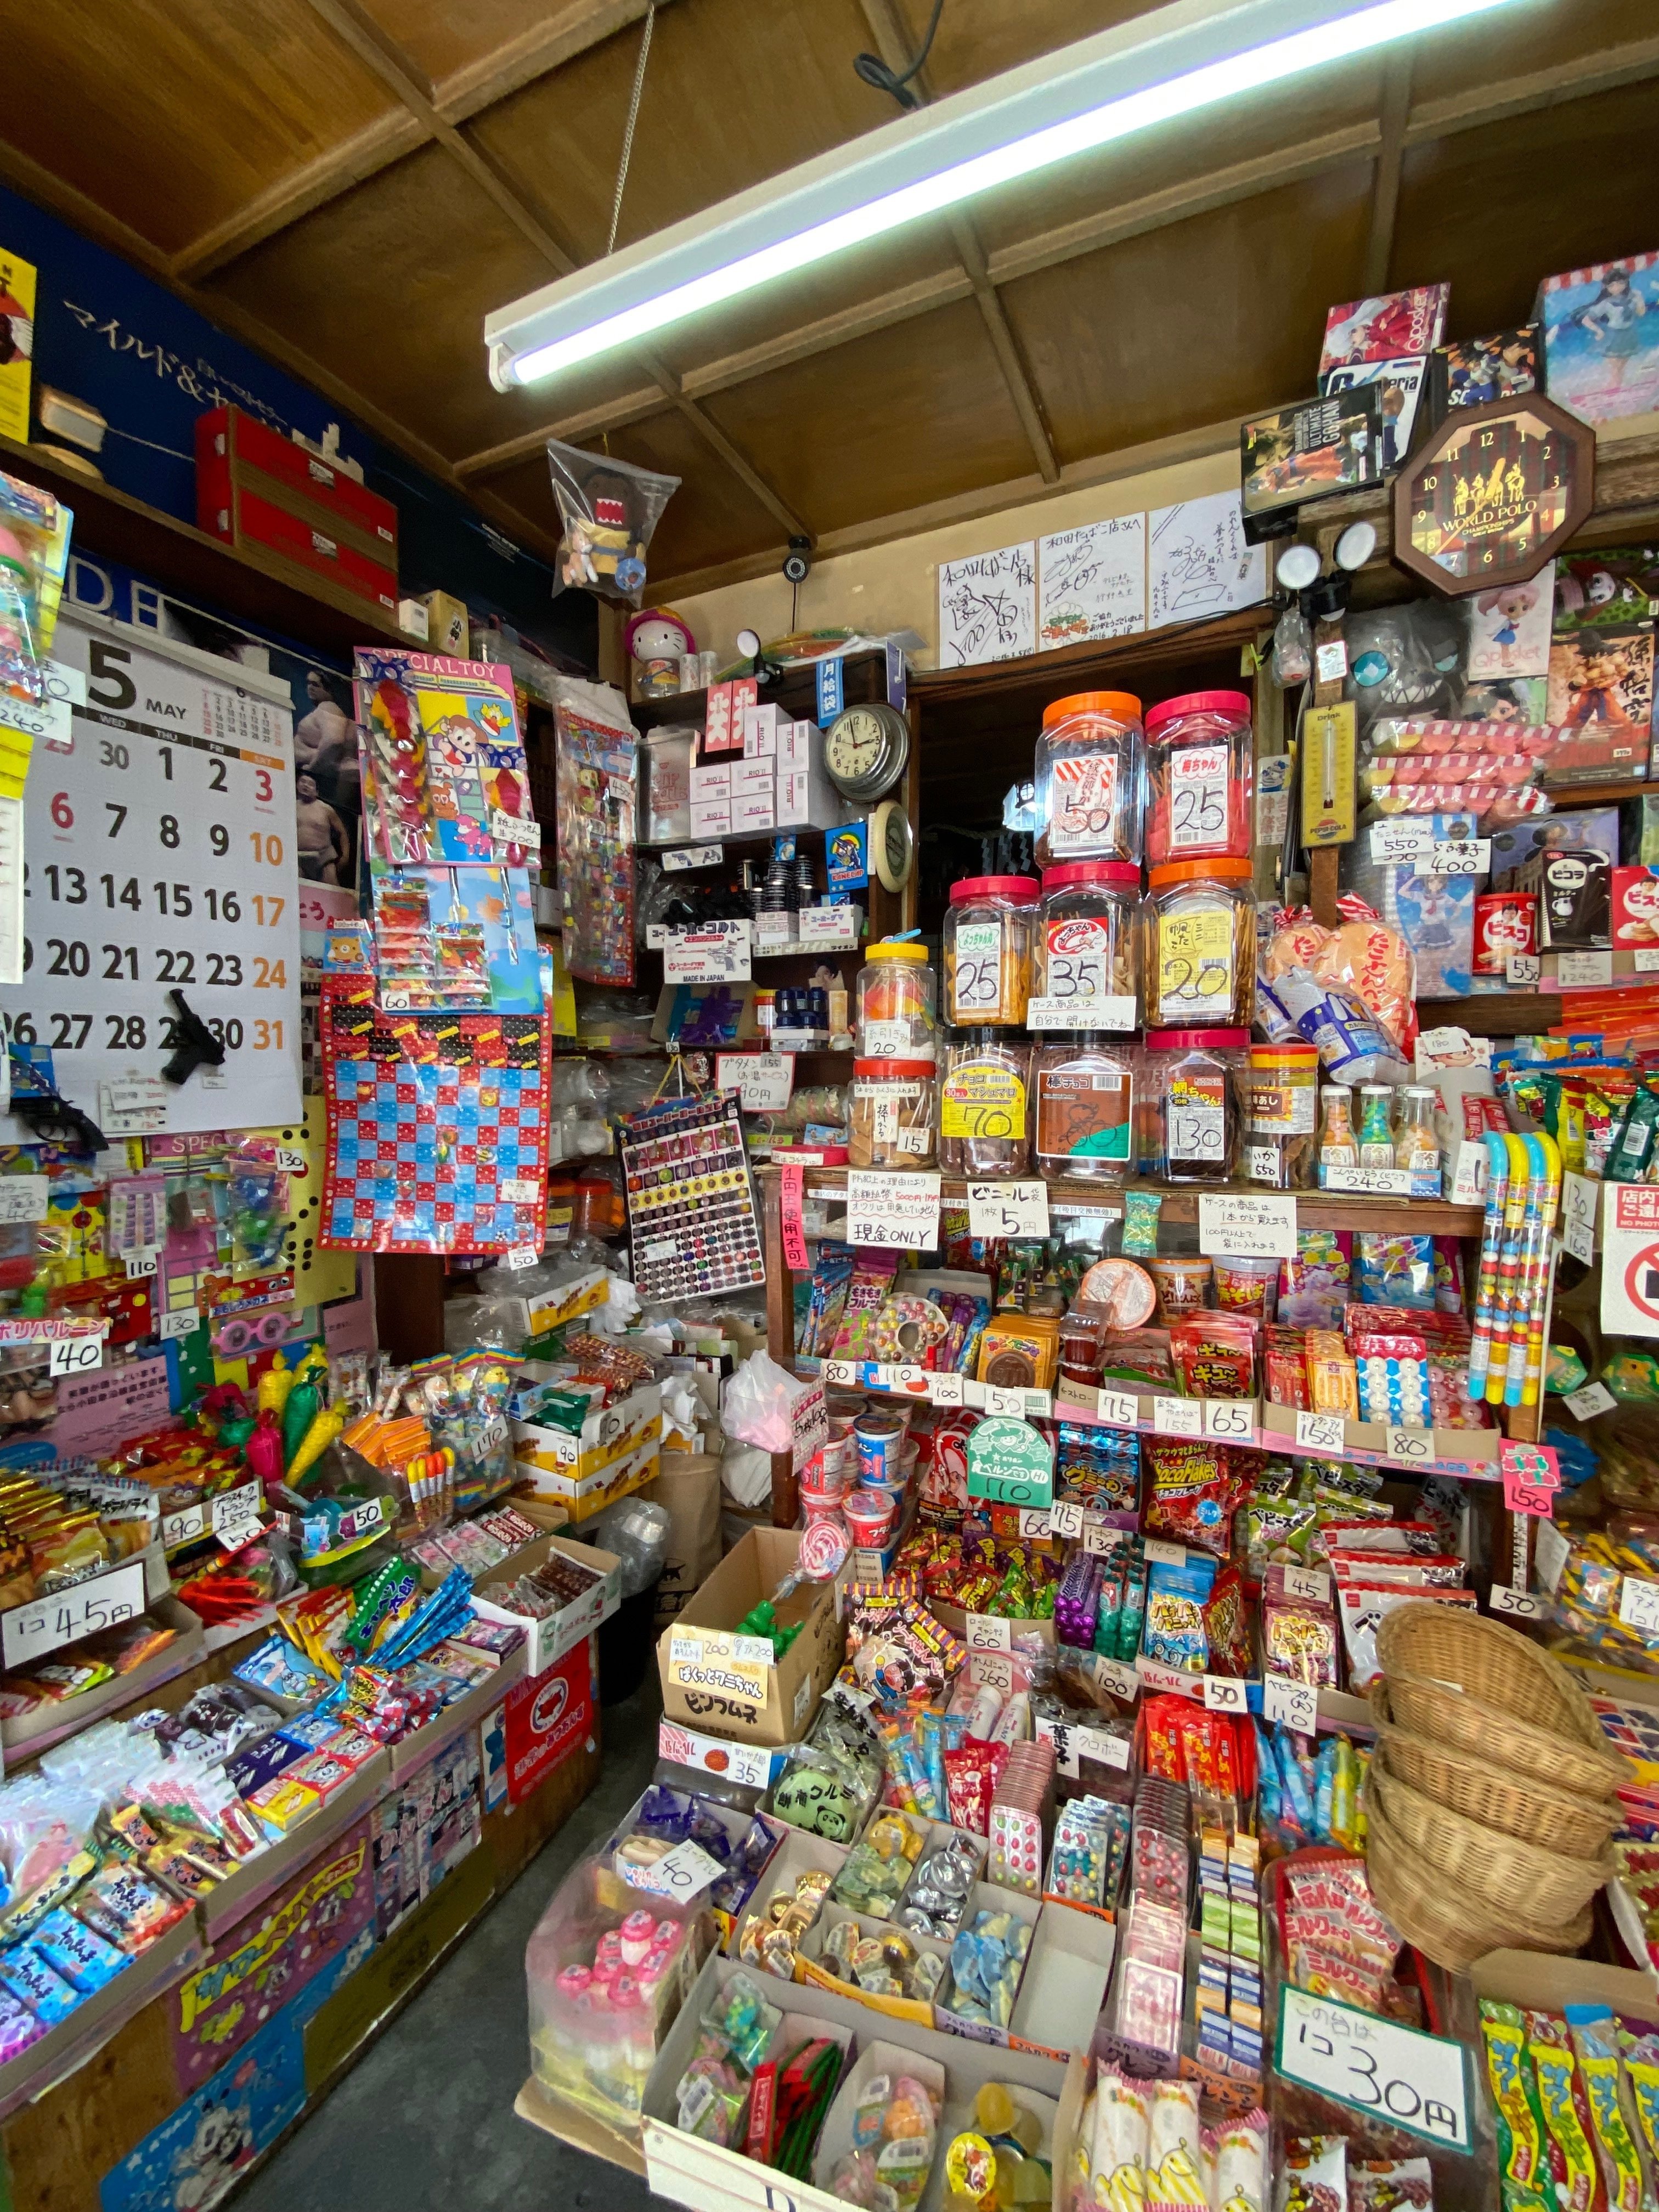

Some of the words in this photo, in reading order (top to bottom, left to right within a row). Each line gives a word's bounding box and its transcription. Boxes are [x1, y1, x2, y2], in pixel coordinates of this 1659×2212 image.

[1310, 406, 1321, 447] ULTIMATE
[1322, 400, 1340, 443] GOHAN
[1481, 432, 1494, 447] 12
[1520, 430, 1525, 442] 1
[1447, 448, 1459, 461] 11
[1543, 447, 1550, 459] 2
[1423, 476, 1437, 490] 10
[1551, 476, 1559, 489] 3
[1418, 510, 1426, 523] 9
[1443, 511, 1493, 532] WORLD
[1498, 500, 1536, 519] POLO
[1542, 509, 1549, 521] 4
[1047, 518, 1142, 549] 和田たばこ店さんへ
[1427, 537, 1436, 549] 8
[1519, 537, 1526, 550] 5
[1451, 555, 1457, 567] 7
[1483, 550, 1492, 562] 6
[1016, 566, 1036, 587] 様
[1090, 614, 1144, 631] ありがとうございました
[88, 639, 136, 709] 5
[236, 686, 245, 698] 6
[823, 663, 837, 710] 月給袋
[145, 698, 186, 720] MAY
[1317, 712, 1341, 721] Drink
[100, 715, 126, 729] WED
[157, 730, 178, 742] THU
[210, 743, 224, 754] FRI
[833, 748, 838, 756] 9
[99, 740, 129, 770] 30
[159, 747, 173, 781] 1
[208, 759, 228, 793] 2
[255, 770, 273, 802] 3
[1182, 757, 1218, 774] 梅ちゃん
[1062, 795, 1110, 834] 50
[1175, 785, 1224, 831] 25
[50, 792, 75, 829] 6
[106, 803, 127, 838] 7
[160, 815, 180, 849] 8
[210, 824, 229, 856] 9
[250, 832, 283, 866] 10
[1310, 824, 1347, 834] PEPSI-COLA
[1385, 840, 1418, 851] 550
[1431, 855, 1477, 873] 400
[832, 869, 864, 882] KANECAP
[1553, 869, 1584, 880] ピコラ
[44, 865, 88, 904] 13
[100, 873, 142, 911] 14
[154, 881, 193, 917] 15
[204, 889, 241, 923] 16
[252, 895, 285, 927] 17
[811, 914, 844, 922] ユーホーダマ
[668, 922, 740, 935] ユーホーコルト
[1488, 920, 1527, 942] ビスコ
[47, 939, 91, 977] 20
[102, 944, 139, 980] 21
[156, 949, 196, 984] 22
[206, 953, 244, 986] 23
[253, 957, 287, 989] 24
[1513, 960, 1539, 981] 550
[956, 959, 997, 1000] 25
[1053, 960, 1099, 997] 35
[1162, 958, 1227, 1001] 20
[385, 994, 407, 1009] 60
[1032, 1000, 1095, 1009] ケース商品は
[1036, 1015, 1131, 1029] 自分で開けないでね
[50, 1013, 93, 1049] 27
[106, 1015, 147, 1049] 28
[208, 1018, 244, 1049] 30
[253, 1019, 284, 1049] 31
[874, 1042, 896, 1054] 20
[1432, 1040, 1449, 1048] 180
[958, 1072, 986, 1085] チョコ
[1046, 1075, 1090, 1090] 棒チョコ
[946, 1088, 967, 1097] 30本入
[969, 1087, 1017, 1098] マシュマロ
[964, 1105, 1012, 1138] 70
[1177, 1118, 1222, 1152] 130
[905, 1136, 923, 1152] 15
[279, 1152, 303, 1167] 130
[1254, 1150, 1276, 1161] いか
[1255, 1164, 1276, 1176] 550
[852, 1174, 926, 1187] 防犯上の理由により
[1346, 1176, 1392, 1189] 240
[851, 1188, 891, 1199] 高額紙幣
[1622, 1190, 1659, 1204] 店内
[1205, 1198, 1271, 1211] ケースの商品は
[1222, 1211, 1289, 1228] 1本から買えます
[854, 1223, 930, 1247] 現金ONLY
[130, 1261, 156, 1276] 110
[514, 1254, 533, 1267] 50
[165, 1317, 195, 1331] 130
[56, 1344, 99, 1370] 40
[827, 1363, 849, 1380] 80
[886, 1368, 911, 1382] 110
[936, 1389, 958, 1399] 100
[993, 1392, 1022, 1412] 50
[1104, 1401, 1135, 1423] 75
[1166, 1419, 1192, 1431] 155
[1212, 1408, 1248, 1434] 65
[476, 1426, 503, 1454] 170
[1301, 1427, 1335, 1446] 150
[1393, 1434, 1427, 1455] 80
[560, 1446, 575, 1462] 90
[1511, 1486, 1550, 1512] 150
[219, 1510, 249, 1531] 250
[356, 1506, 379, 1526] 50
[1054, 1505, 1079, 1533] 75
[171, 1517, 201, 1538] 90
[1025, 1514, 1052, 1536] 60
[1088, 1537, 1113, 1552] 130
[1293, 1579, 1321, 1598] 45
[1499, 1594, 1535, 1612] 50
[706, 1640, 729, 1656] 200
[973, 1633, 1001, 1648] 60
[973, 1656, 1009, 1672] れんにゅう
[979, 1669, 1009, 1688] 260
[1098, 1673, 1128, 1694] 100
[1211, 1683, 1238, 1705] 50
[685, 1692, 758, 1724] ビンラムネ
[1273, 1706, 1307, 1726] 110
[1079, 1735, 1124, 1758] クロボー
[735, 1761, 760, 1784] 35
[663, 1856, 693, 1887] 40
